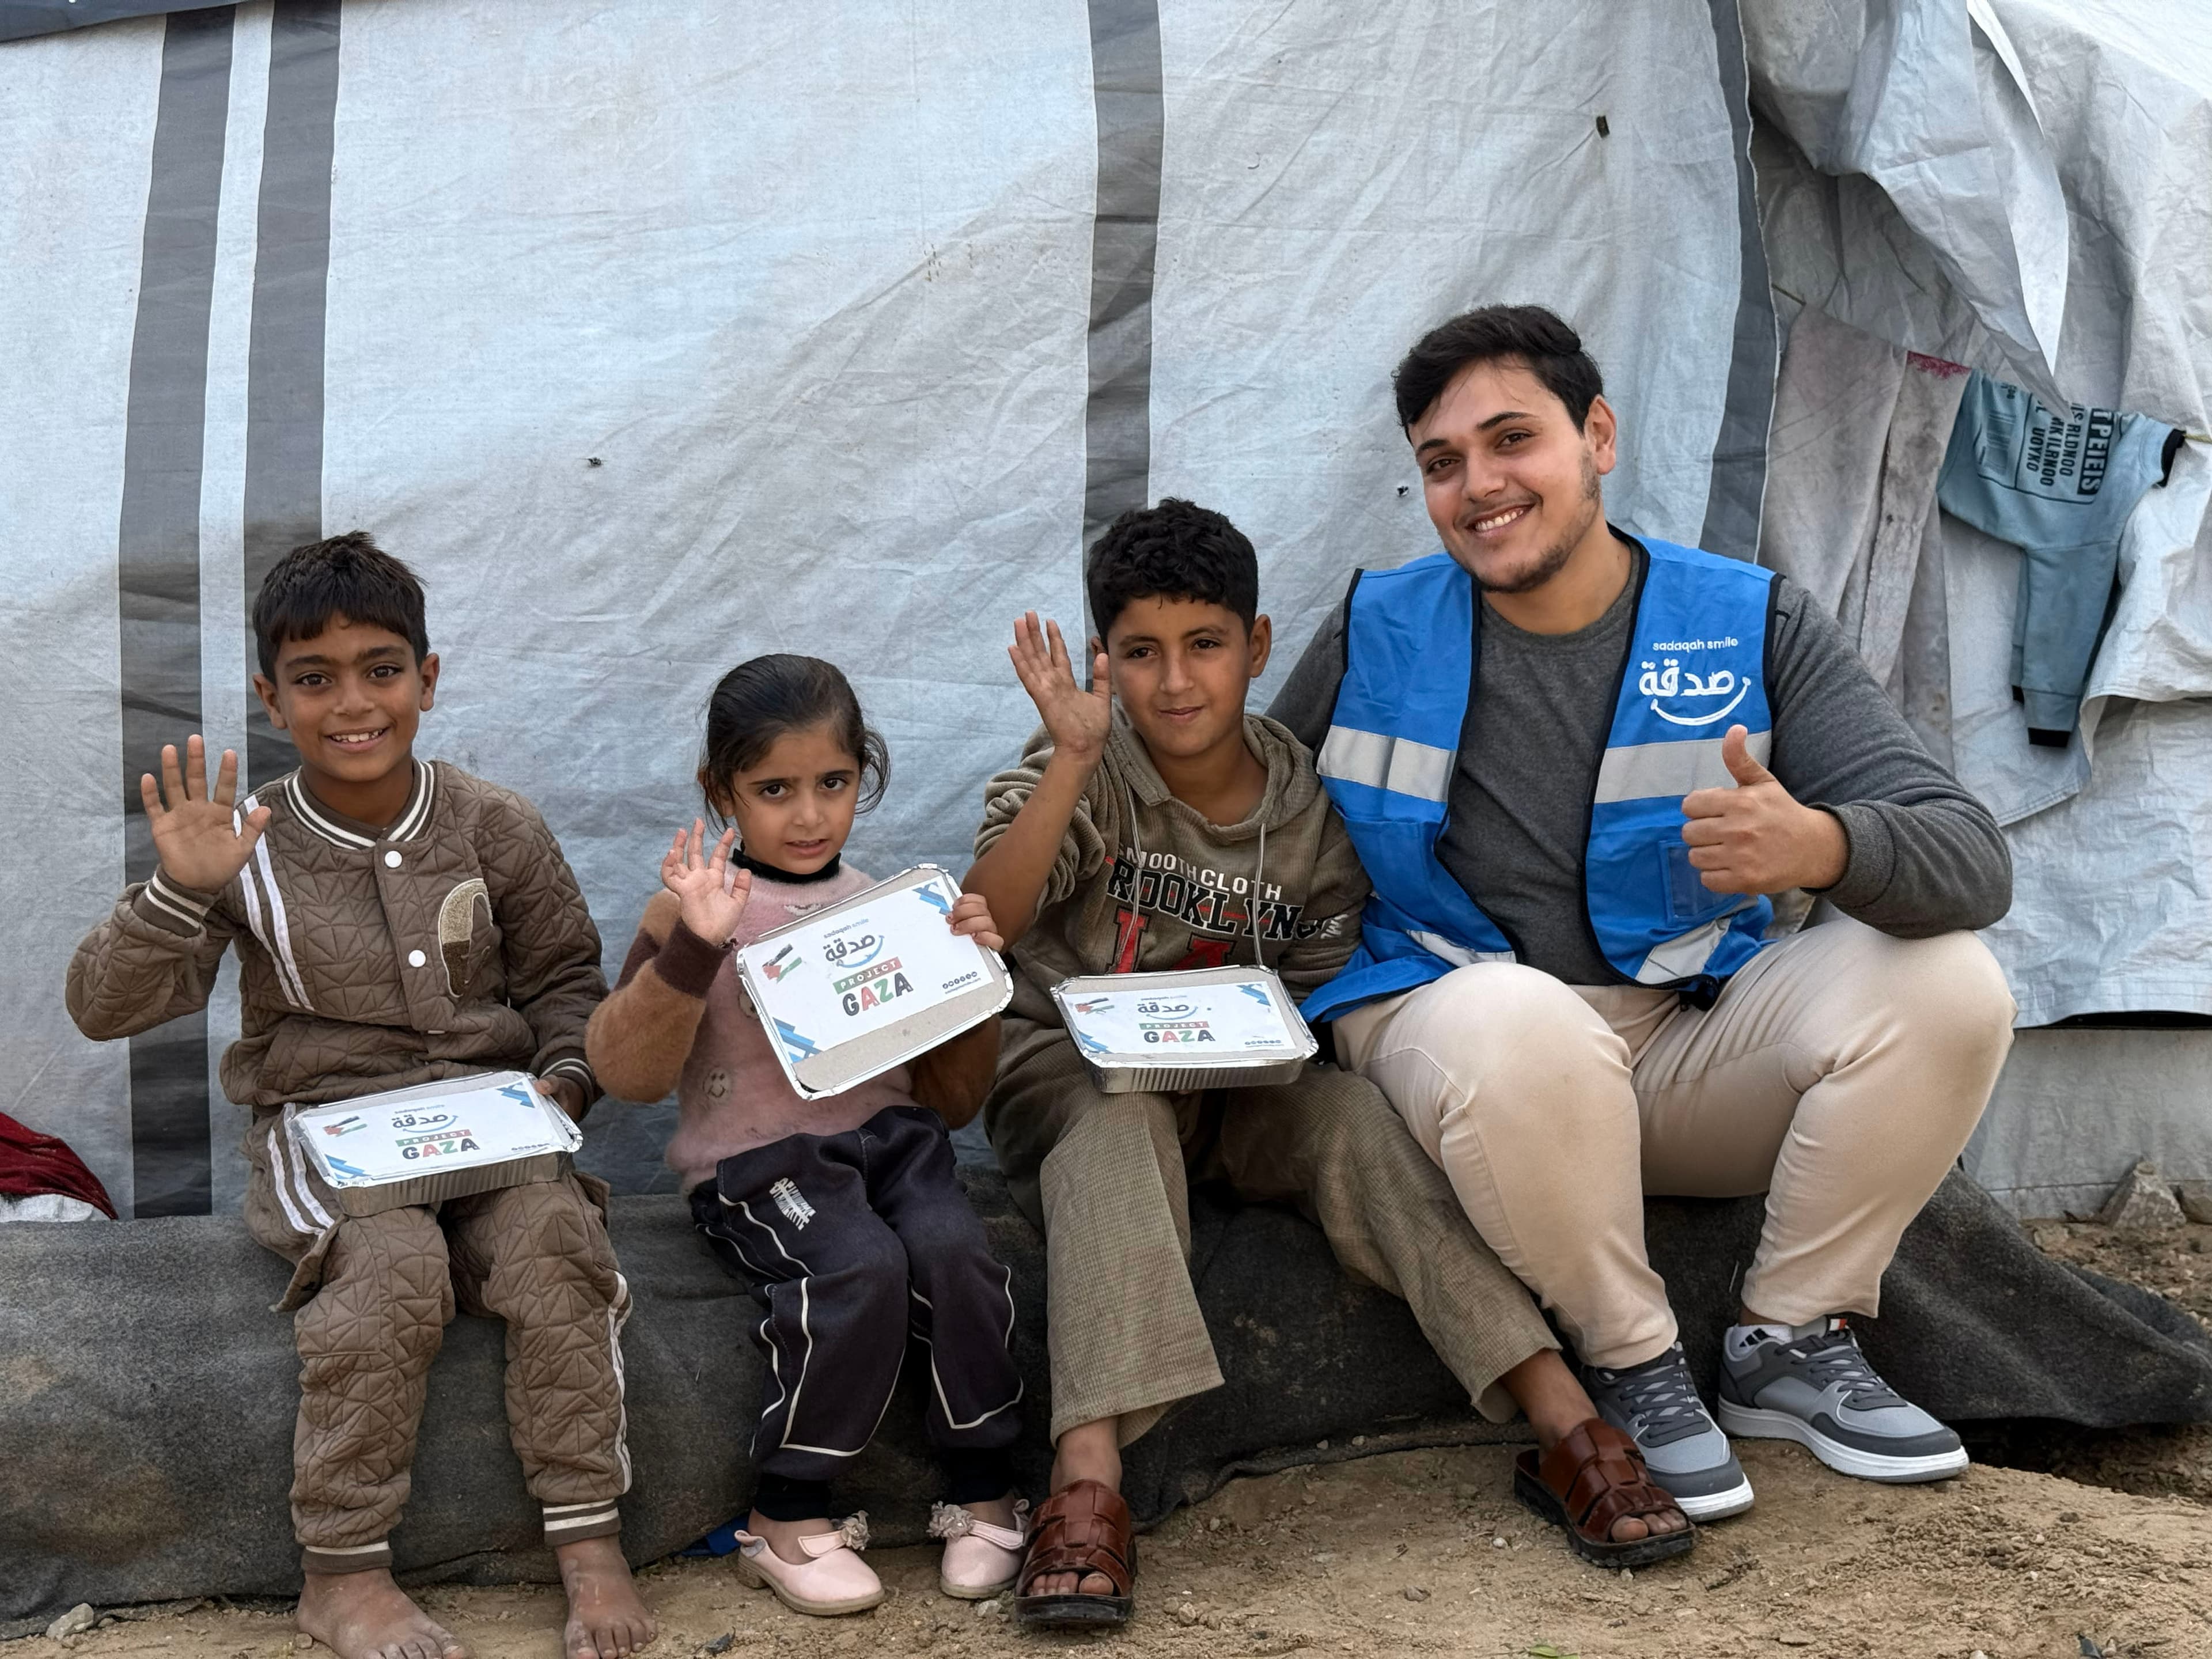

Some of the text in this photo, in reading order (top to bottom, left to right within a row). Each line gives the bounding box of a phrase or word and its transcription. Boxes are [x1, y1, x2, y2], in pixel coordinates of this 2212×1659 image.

[1653, 637, 1738, 653] sadaqah smile
[1639, 658, 1735, 697] صدقة
[823, 935, 875, 961] صدقة
[840, 961, 897, 990] PROJECT
[843, 972, 914, 1016] GAZA
[1137, 1002, 1190, 1013] صدقة
[1144, 1030, 1216, 1043] GAZA
[391, 1114, 448, 1128] صدقة
[403, 1131, 466, 1145] PROJECT
[402, 1138, 480, 1160] GAZA
